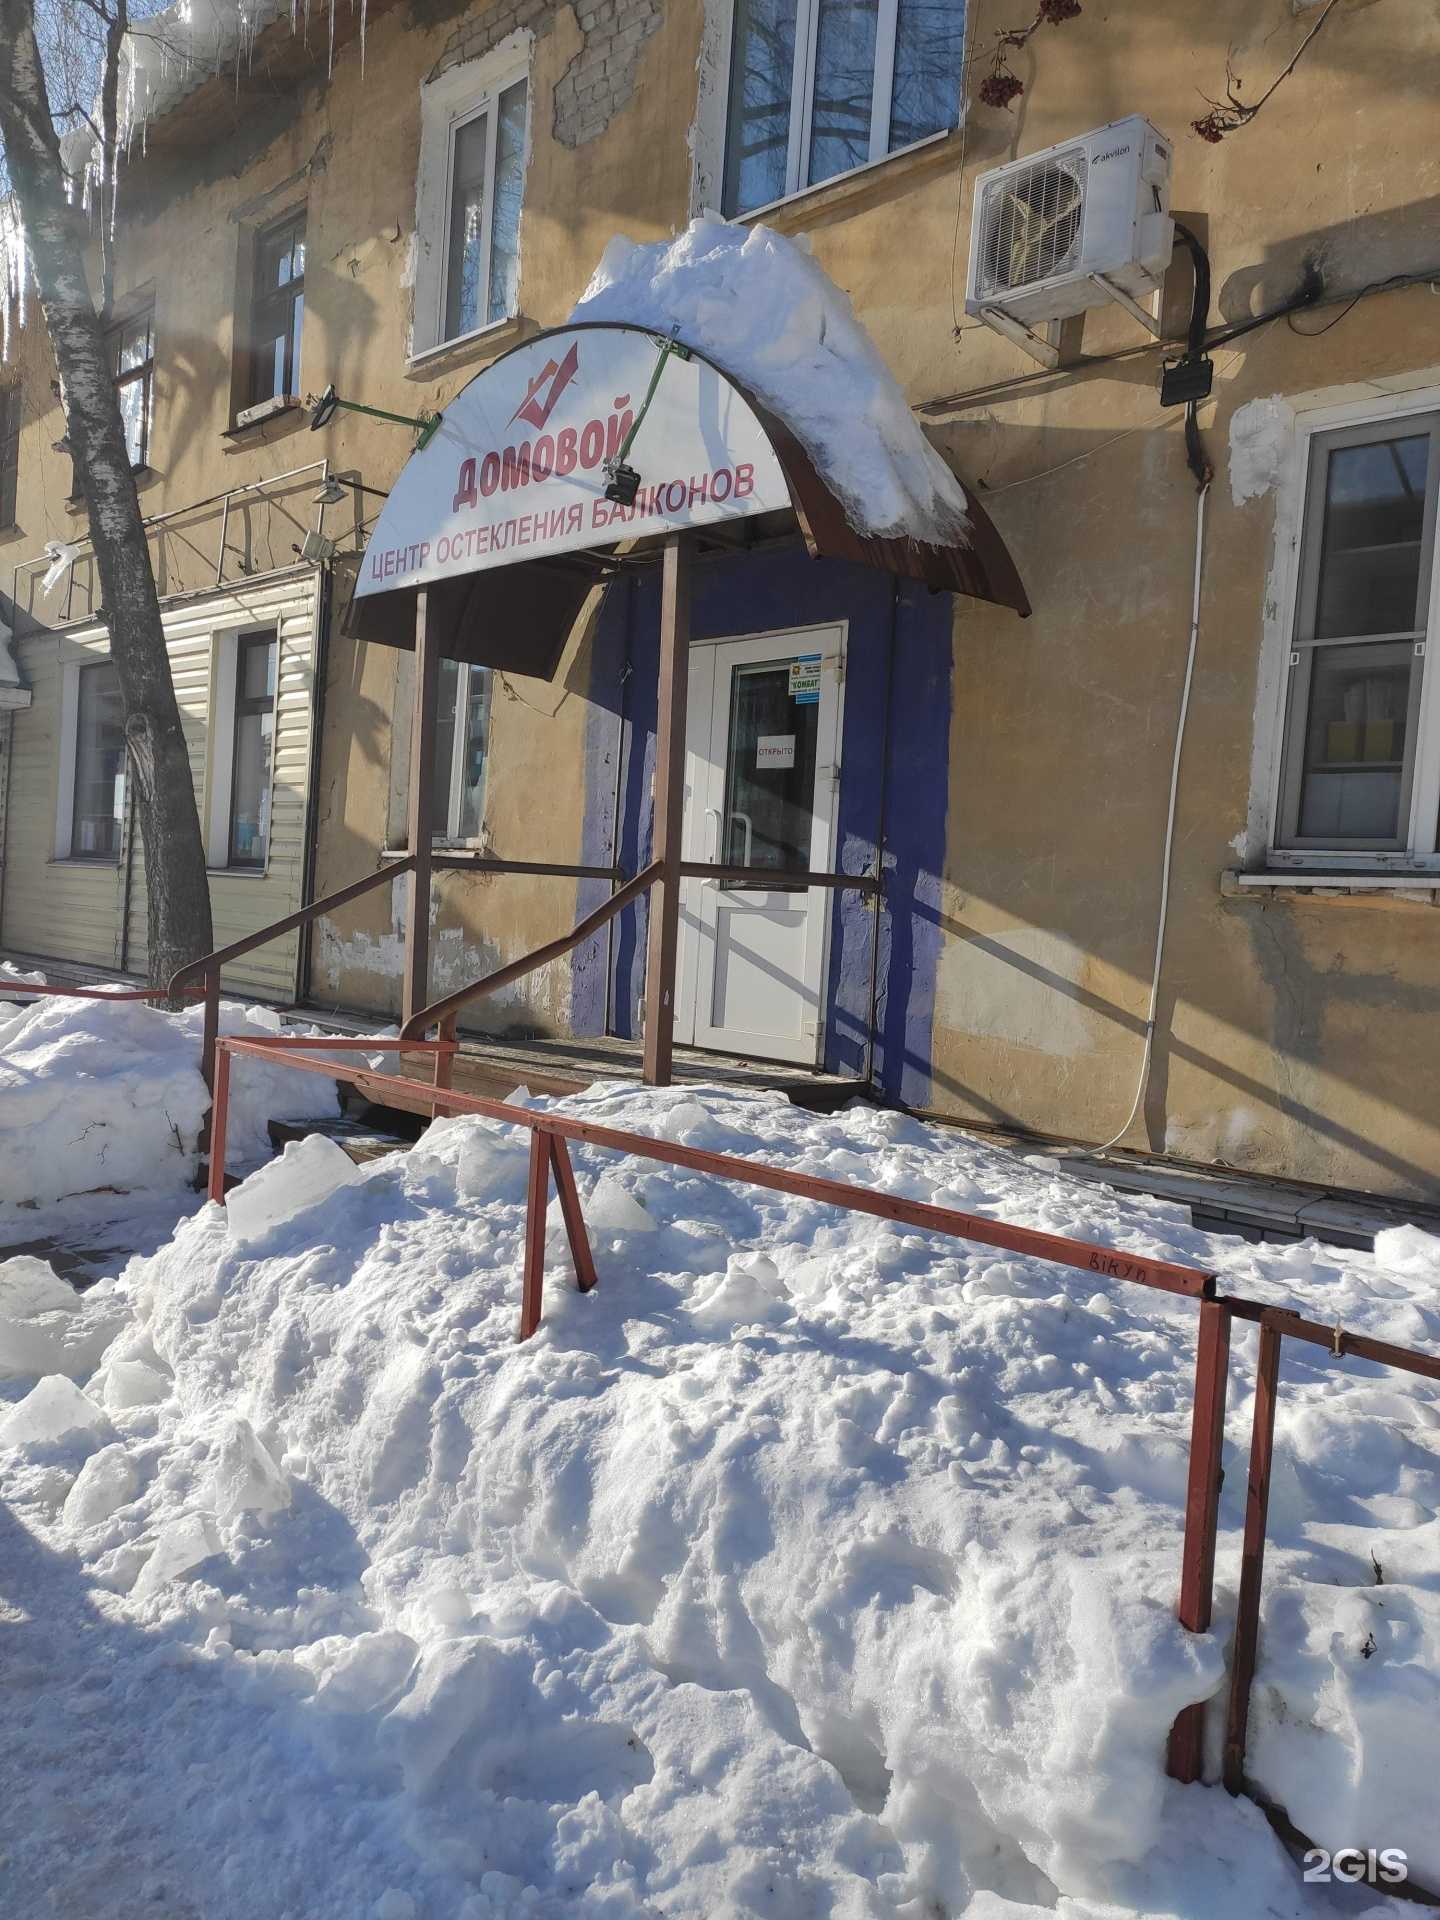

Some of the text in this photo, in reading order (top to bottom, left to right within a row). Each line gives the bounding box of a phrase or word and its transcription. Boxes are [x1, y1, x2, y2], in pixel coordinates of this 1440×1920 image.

[452, 394, 635, 513] ДОМОВОЙ
[371, 463, 755, 582] ЦЕНТР ОСТЕКЛЕНИЯ БАЛКОНОВ
[758, 747, 793, 756] ОТКРЫТО
